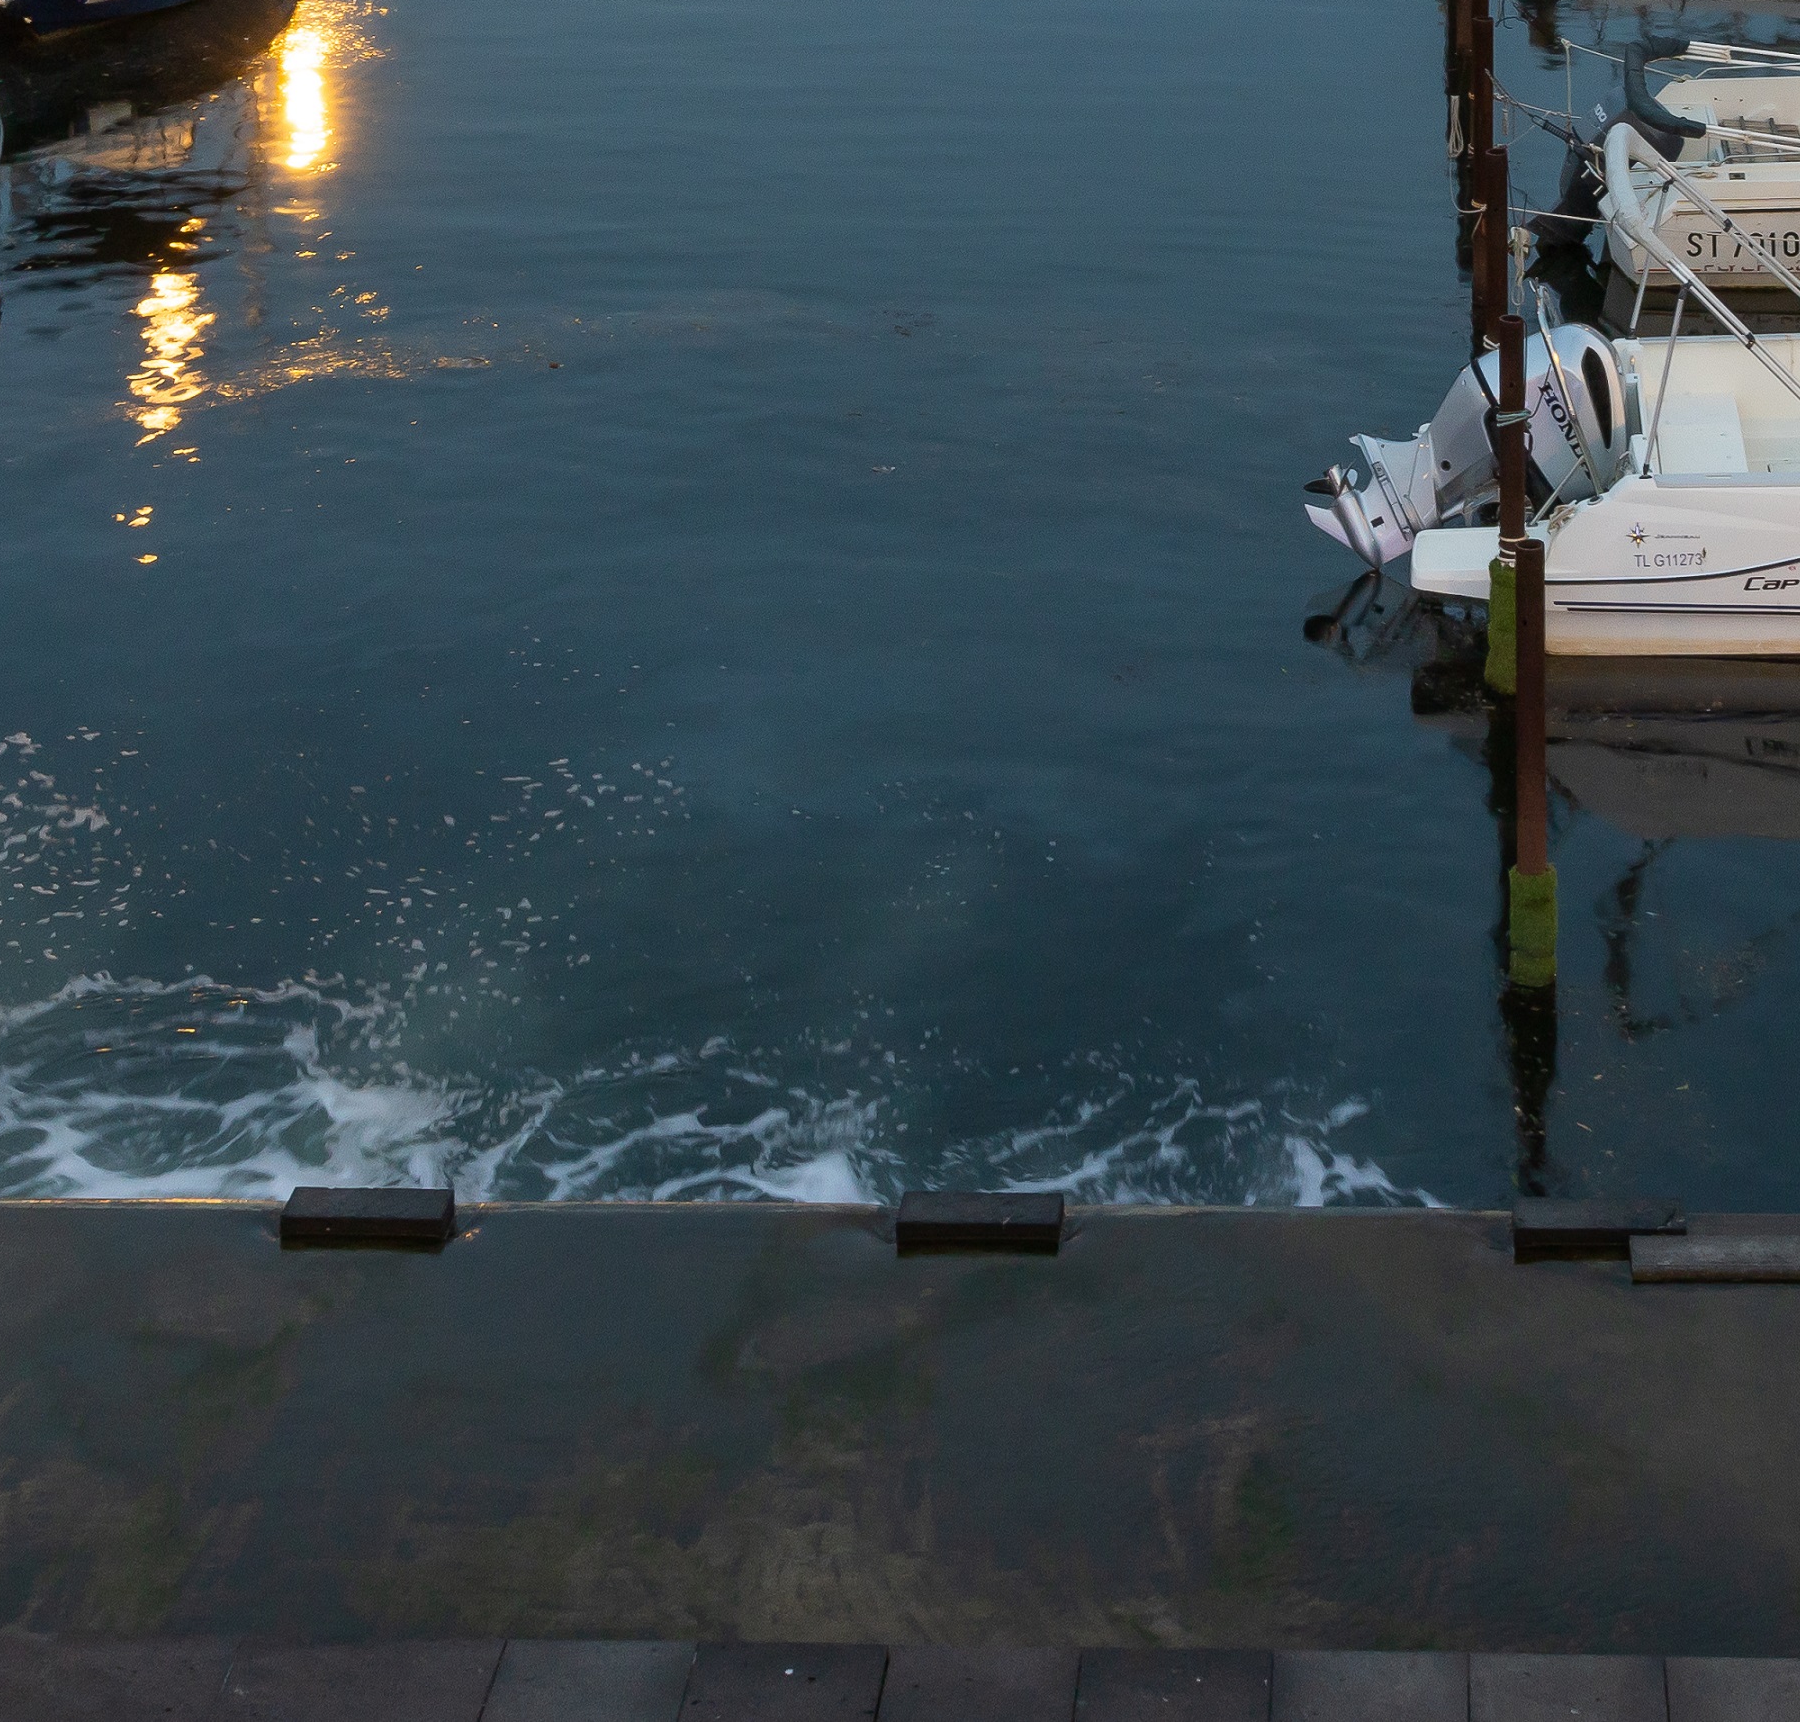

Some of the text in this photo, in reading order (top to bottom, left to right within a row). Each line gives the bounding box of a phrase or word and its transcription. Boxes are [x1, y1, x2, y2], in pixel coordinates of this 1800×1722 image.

[1686, 231, 1722, 258] ST
[1634, 554, 1651, 568] TL
[1743, 576, 1800, 591] Cap
